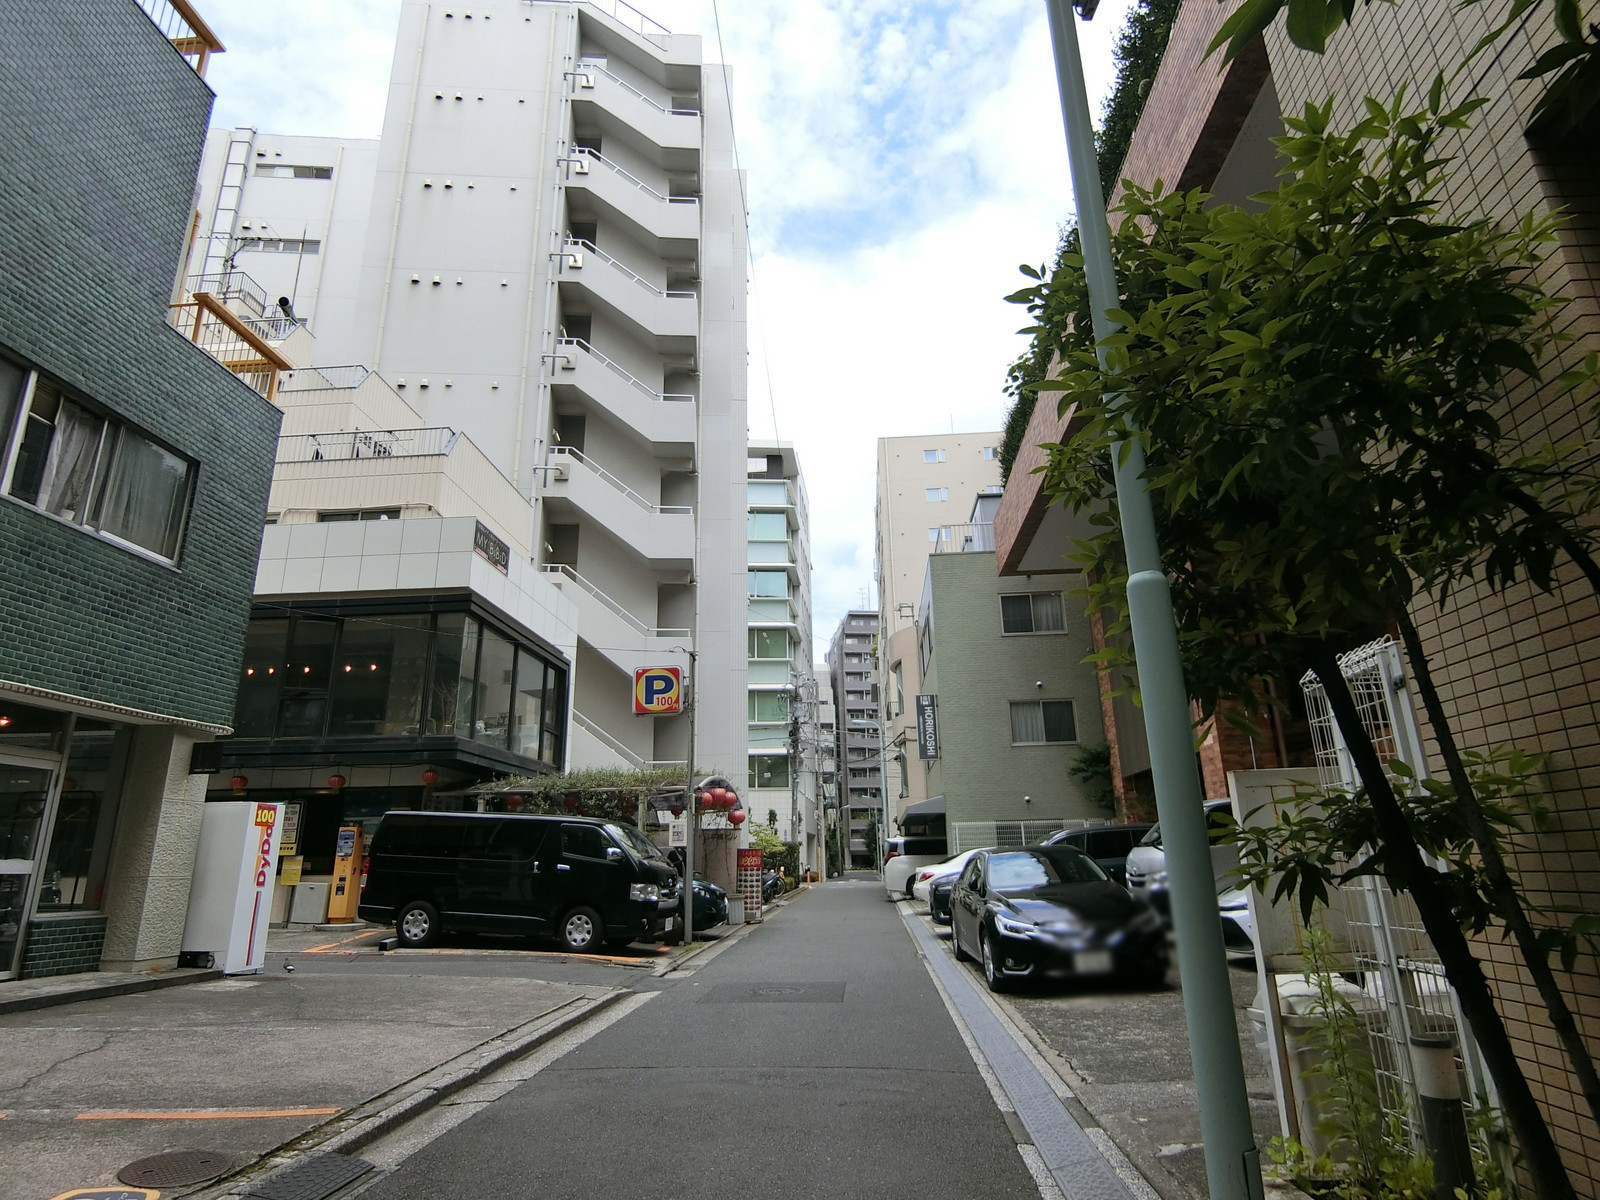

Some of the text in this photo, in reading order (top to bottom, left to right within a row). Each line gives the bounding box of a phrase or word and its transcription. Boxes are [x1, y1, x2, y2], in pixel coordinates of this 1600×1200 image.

[644, 674, 675, 706] P
[656, 696, 673, 706] 100
[924, 706, 936, 756] HORIKOSHI
[256, 808, 275, 824] 100
